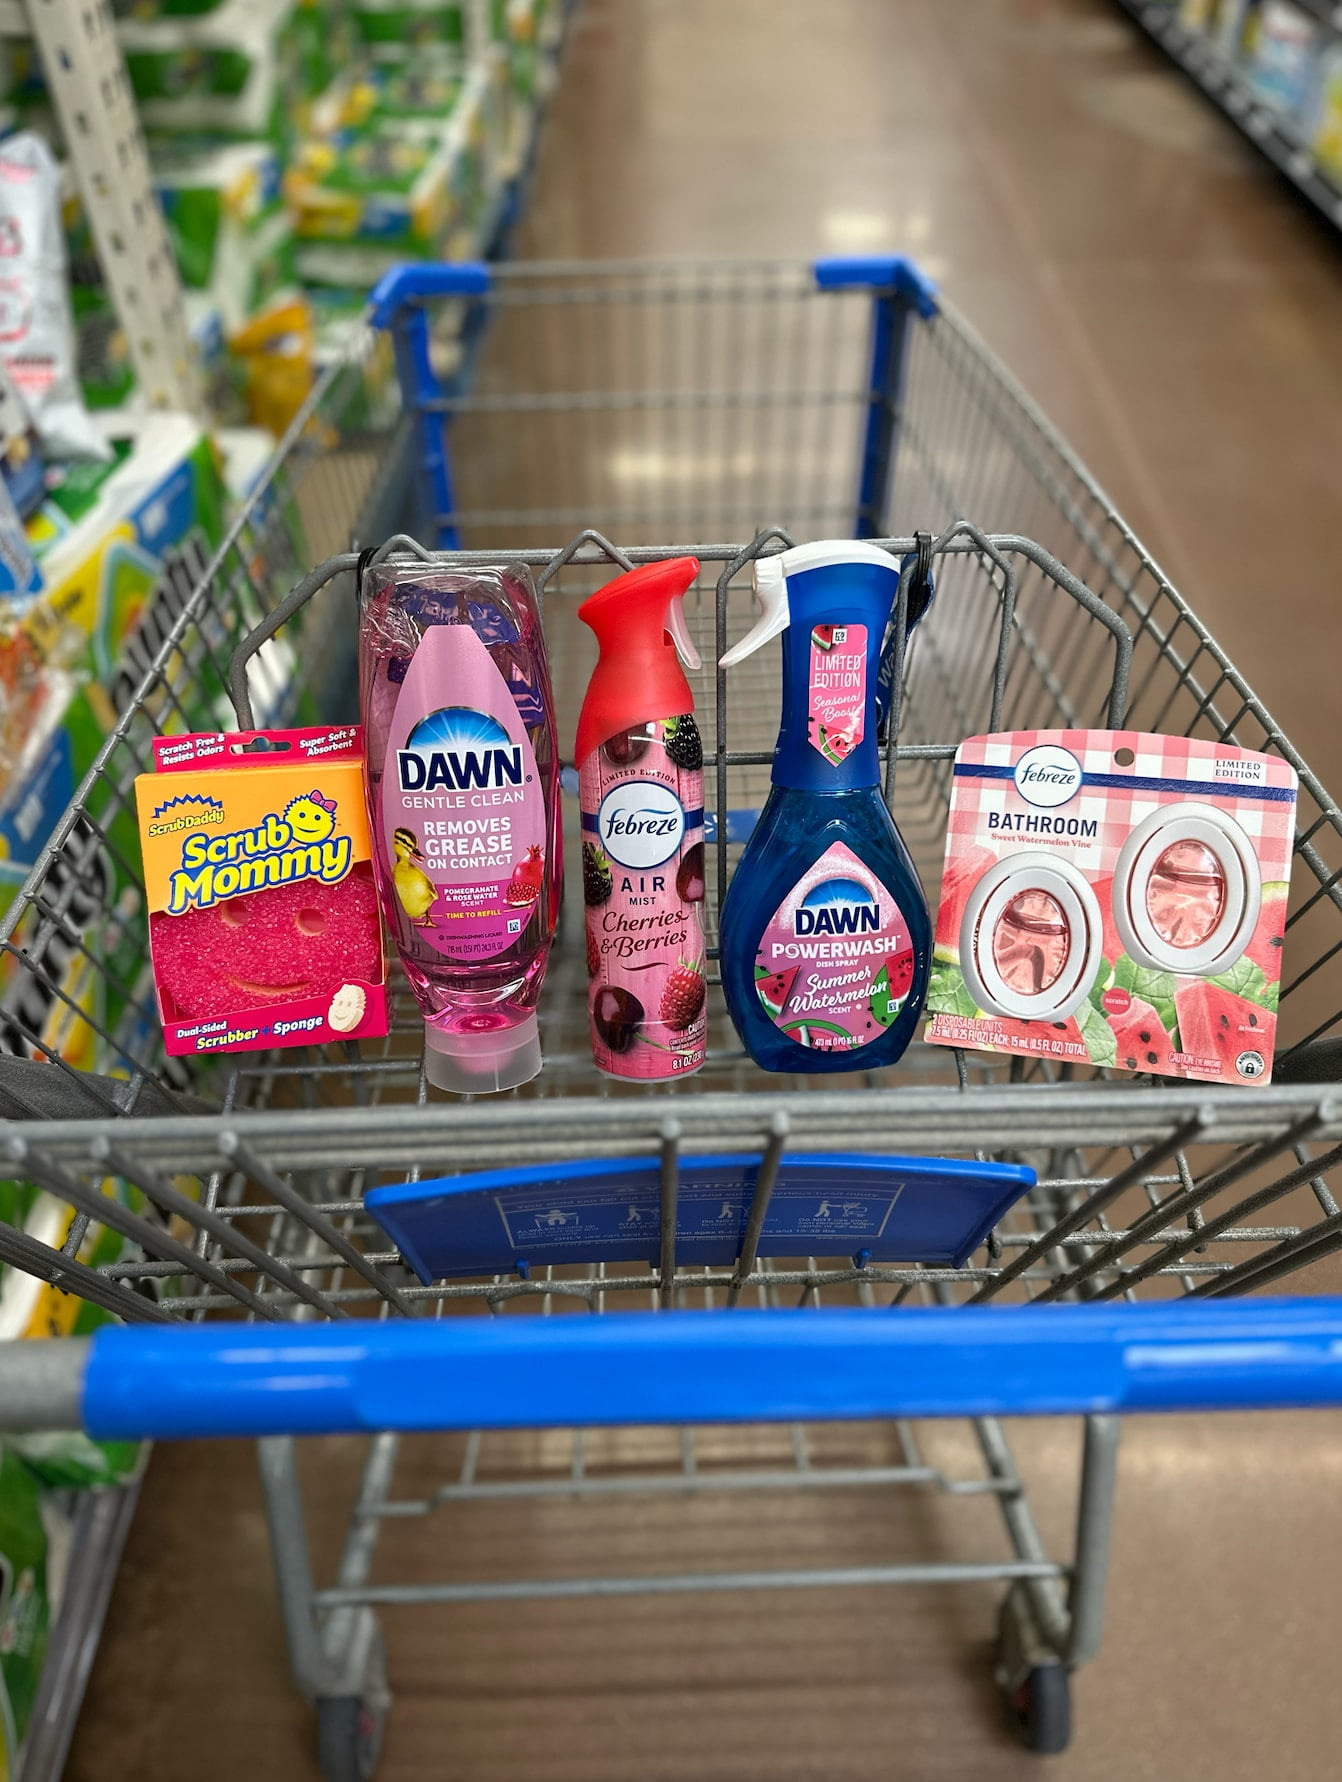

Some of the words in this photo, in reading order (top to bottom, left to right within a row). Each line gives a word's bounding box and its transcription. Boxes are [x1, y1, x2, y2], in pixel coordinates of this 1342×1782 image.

[815, 655, 861, 670] LIMITED
[814, 672, 861, 687] EDITION
[812, 692, 861, 711] Seasonal
[822, 706, 858, 723] Boost
[158, 740, 193, 757] Scratch
[195, 736, 216, 750] Free
[217, 733, 225, 744] &
[299, 734, 328, 749] Super
[328, 730, 348, 745] Soft
[348, 728, 357, 738] &
[306, 739, 354, 757] Absorbent
[162, 749, 195, 765] Resists
[196, 744, 225, 758] Odors
[398, 747, 523, 791] DAWN
[1020, 762, 1076, 785] febreze
[1215, 760, 1261, 770] LIMITED
[1215, 769, 1261, 780] EDITION
[602, 768, 637, 786] LIMITED
[401, 796, 466, 810] GENTLE
[471, 790, 525, 808] CLEAN
[423, 816, 512, 837] REMOVES
[605, 808, 678, 840] febreze
[987, 811, 1098, 838] BATHROOM
[183, 815, 293, 870] Scrub
[424, 834, 513, 857] GREASE
[990, 832, 1016, 842] Sweet
[1017, 834, 1071, 847] Watermelon
[1072, 839, 1092, 849] Vine
[426, 858, 446, 870] ON
[450, 853, 513, 870] CONTACT
[170, 836, 351, 913] Mommy
[443, 885, 499, 895] POMEGRANATE
[620, 876, 666, 893] AIR
[452, 894, 472, 902] ROSE
[472, 892, 499, 900] WATER
[629, 896, 657, 906] MIST
[445, 912, 464, 920] TIME
[476, 909, 502, 918] REFILL
[602, 909, 690, 933] Cherries
[795, 904, 880, 936] DAWN
[771, 936, 897, 959] POWERWASH
[816, 960, 834, 968] DISH
[835, 959, 859, 967] SPRAY
[804, 965, 872, 996] Summer
[788, 981, 888, 1014] Watermelon
[828, 1006, 852, 1014] SCENT
[176, 1020, 228, 1039] Dual-Sided
[196, 1027, 259, 1050] Scrubber
[272, 1015, 324, 1038] Sponge
[932, 1013, 938, 1025] 2
[938, 1014, 980, 1031] DISPOSABLE
[981, 1020, 1003, 1033] UNITS
[1064, 1042, 1087, 1056] TOTAL
